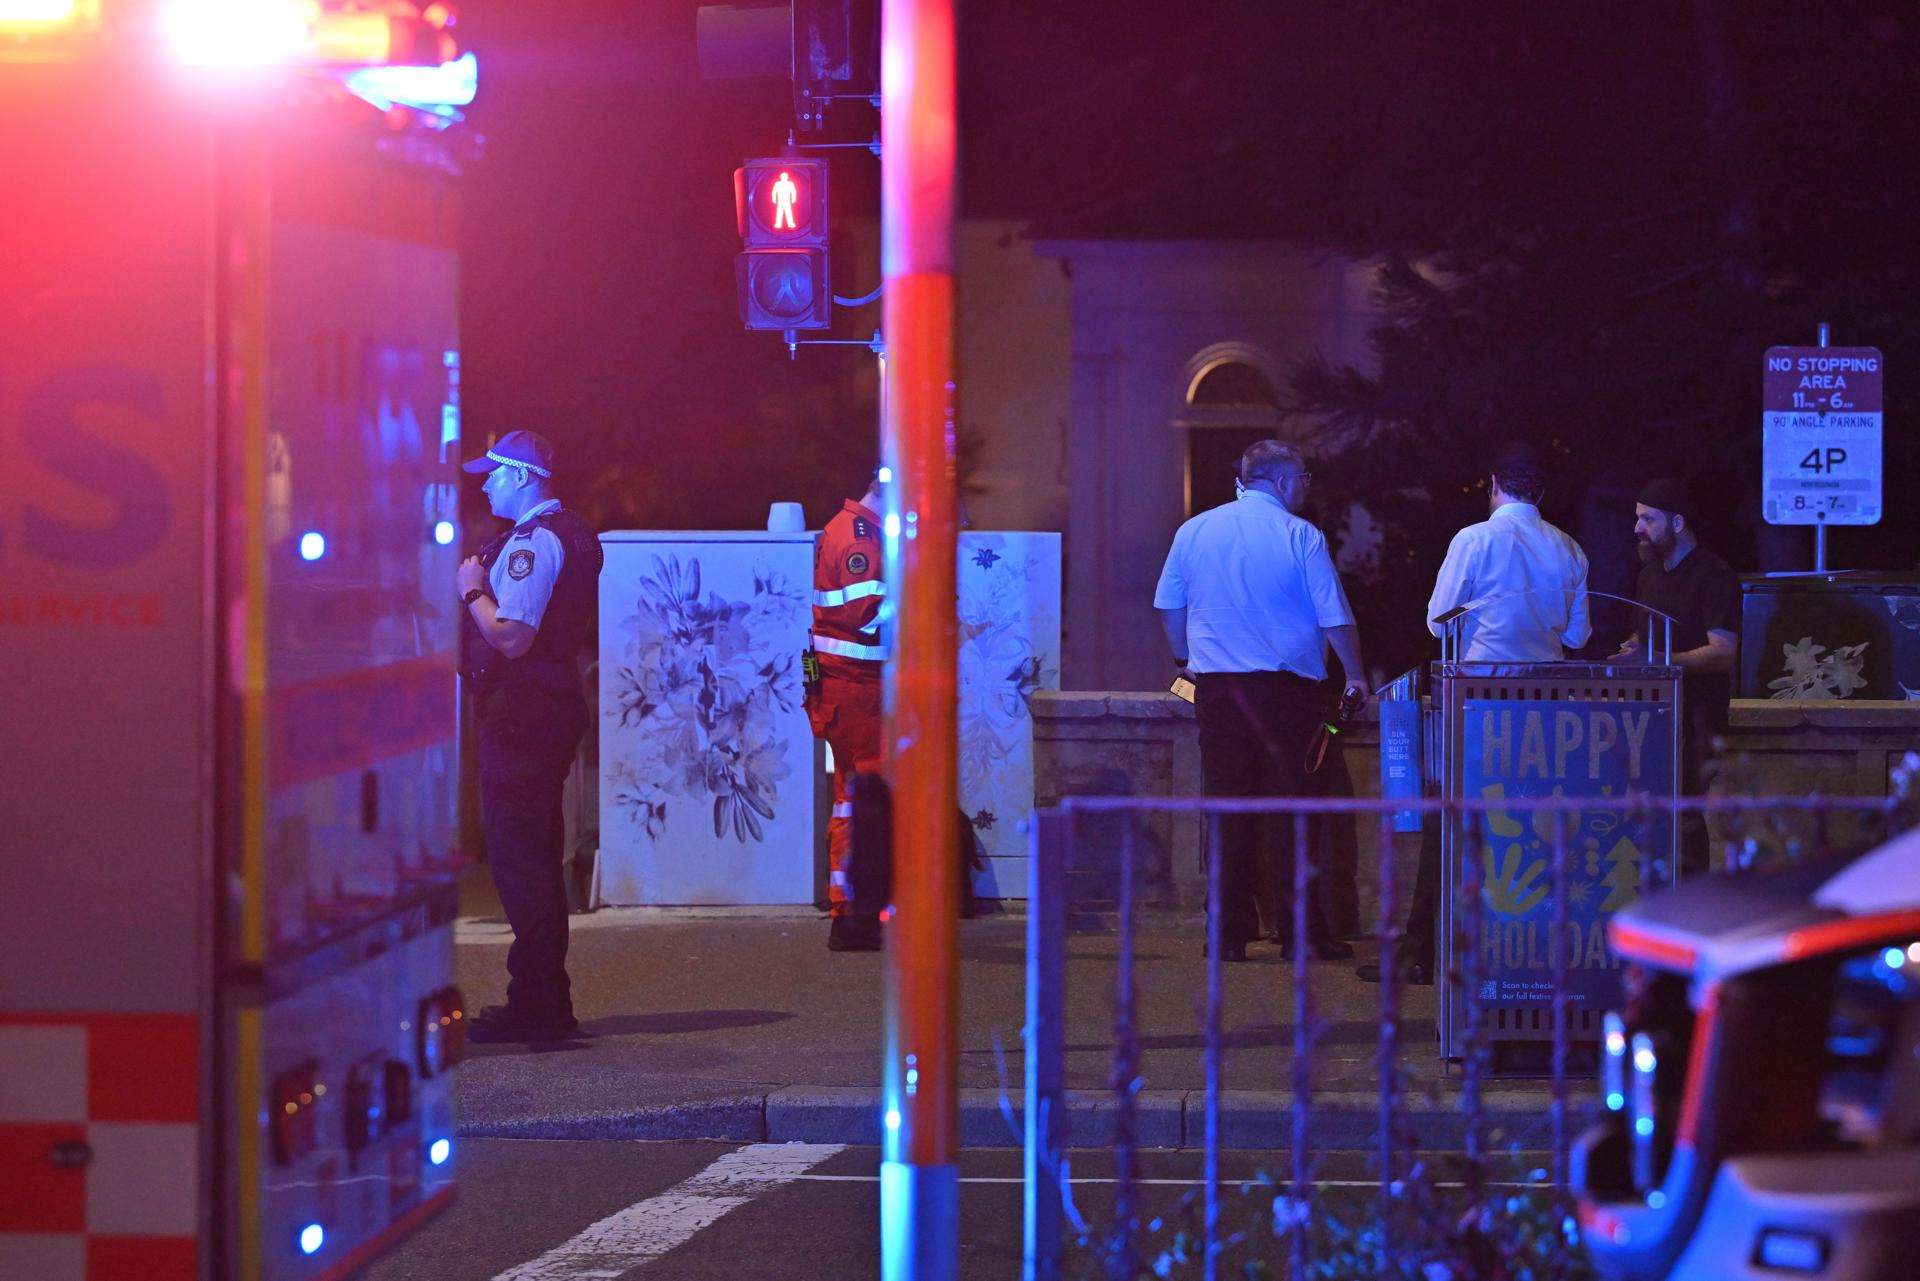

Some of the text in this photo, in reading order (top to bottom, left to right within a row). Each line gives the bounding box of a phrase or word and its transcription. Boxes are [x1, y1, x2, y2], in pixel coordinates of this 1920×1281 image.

[1768, 358, 1878, 372] NO STOPPING
[1798, 375, 1847, 389] AREA
[1792, 416, 1826, 428] ANGLE
[1830, 416, 1874, 428] PARKING
[1799, 447, 1847, 474] 4P
[1482, 710, 1650, 779] HAPPY
[1388, 753, 1410, 761] HERE
[1502, 981, 1520, 989] Scan
[1516, 991, 1528, 1000] full
